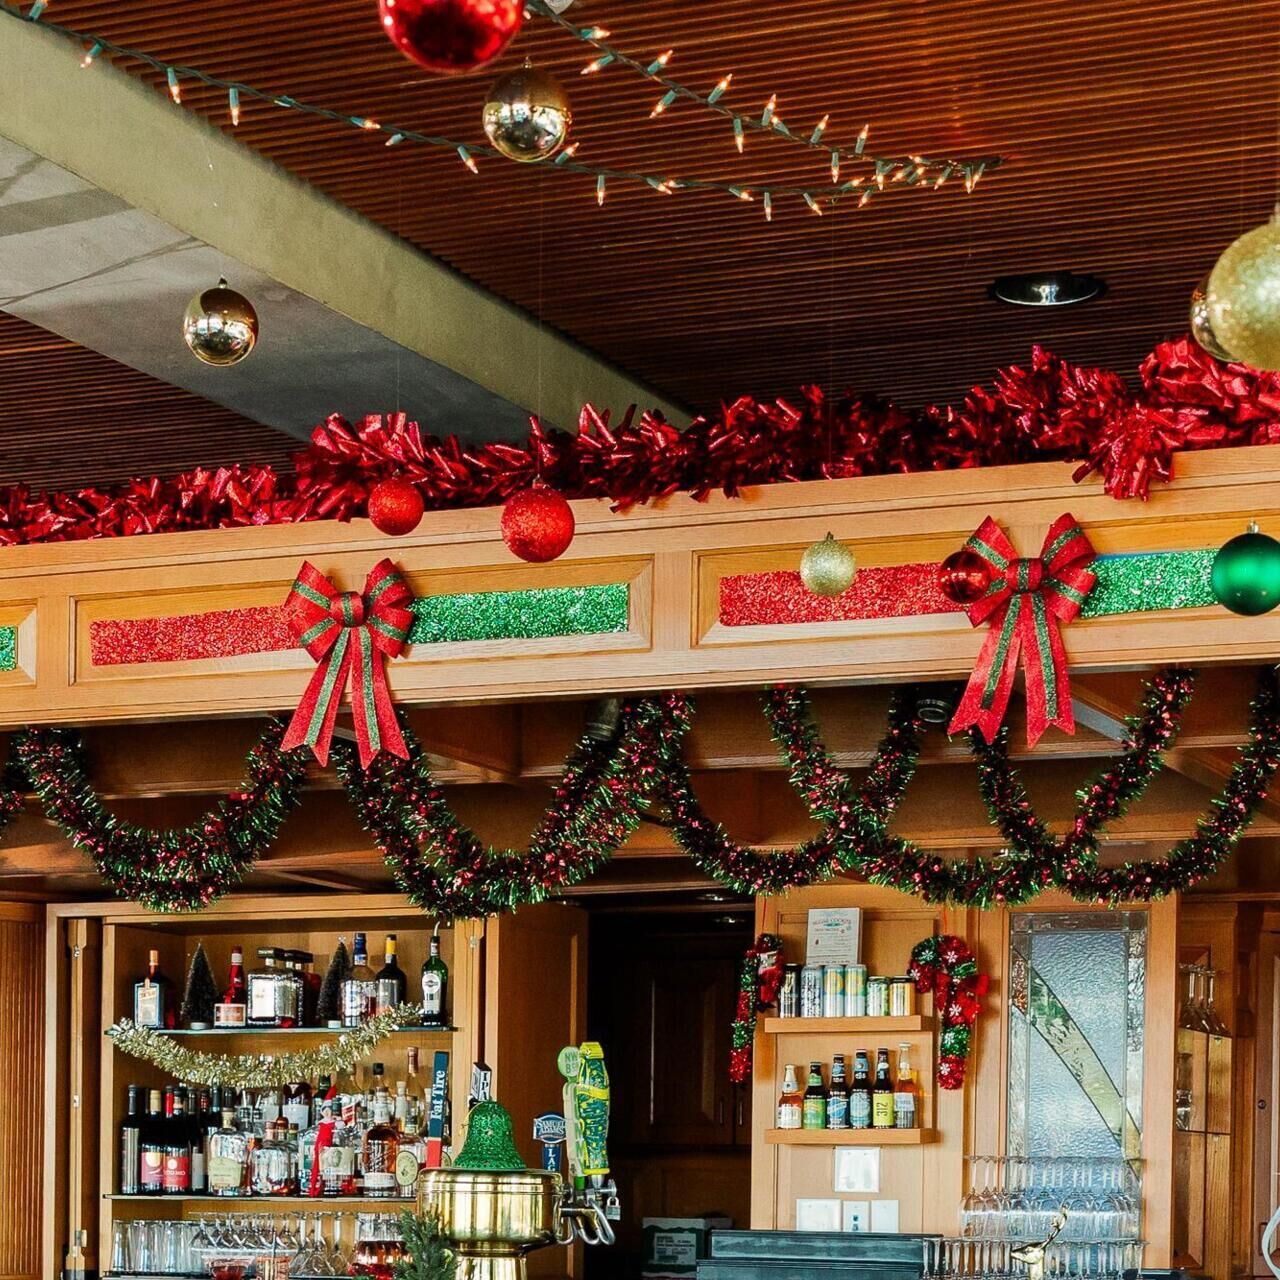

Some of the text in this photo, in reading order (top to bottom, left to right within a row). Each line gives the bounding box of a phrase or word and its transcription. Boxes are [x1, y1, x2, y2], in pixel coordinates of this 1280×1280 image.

[430, 1070, 446, 1121] Fat Tire
[480, 1072, 489, 1100] IPA
[875, 1102, 888, 1117] 312
[547, 1148, 556, 1171] LAG
